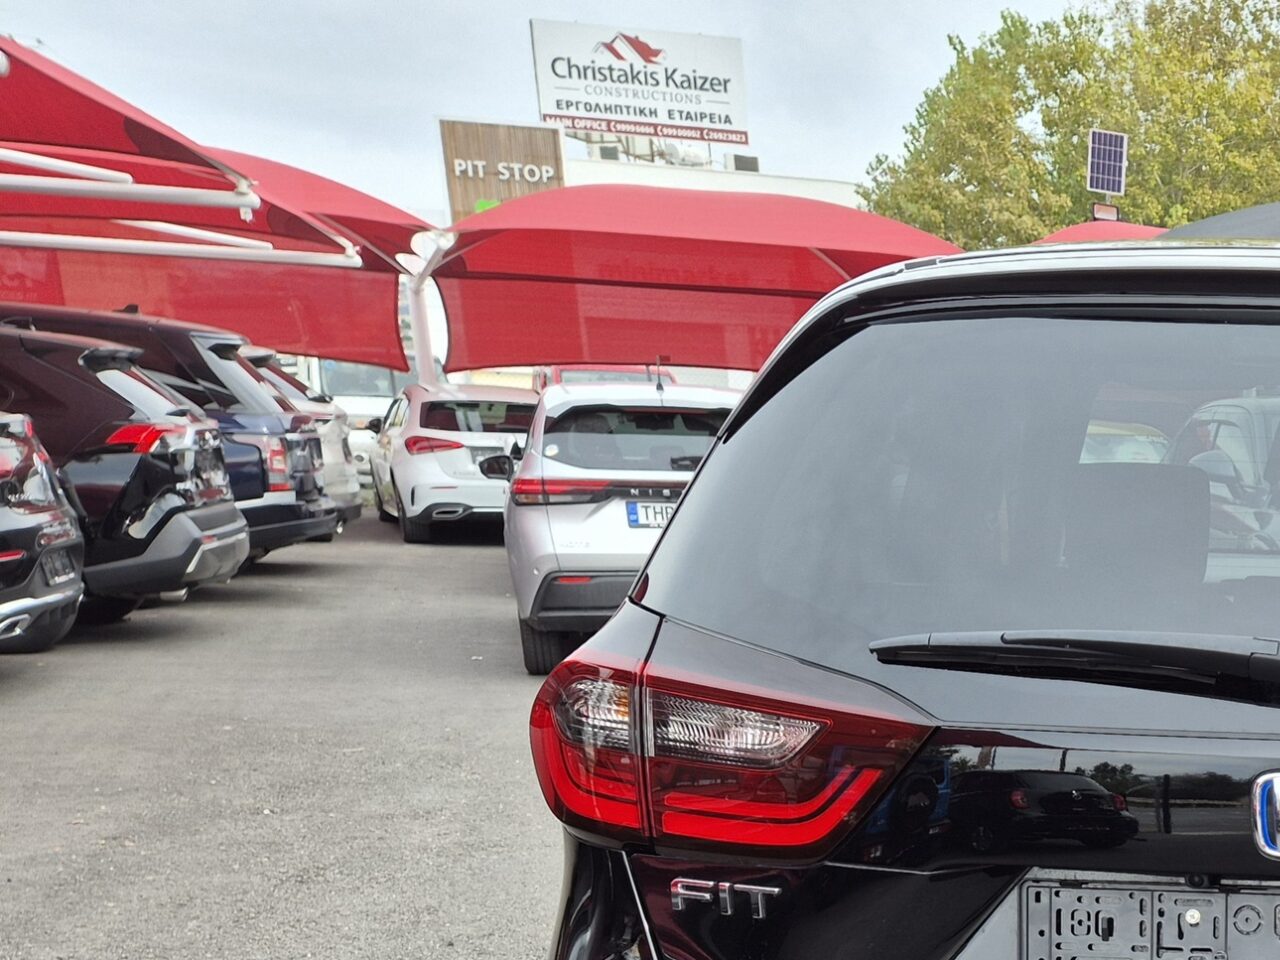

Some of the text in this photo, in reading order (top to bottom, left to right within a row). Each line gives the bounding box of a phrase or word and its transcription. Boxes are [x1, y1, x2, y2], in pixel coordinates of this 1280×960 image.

[551, 56, 731, 94] Christakis Kaizer
[584, 84, 702, 105] CONSTRUCTIONS
[556, 99, 733, 126] ΕΡΓΟΛΗΠΤΙΚΗ ΕΤΑΙΡΕΙΑ
[573, 118, 609, 131] OFFICE
[454, 158, 555, 183] PIT STOP
[670, 878, 781, 919] FIT
